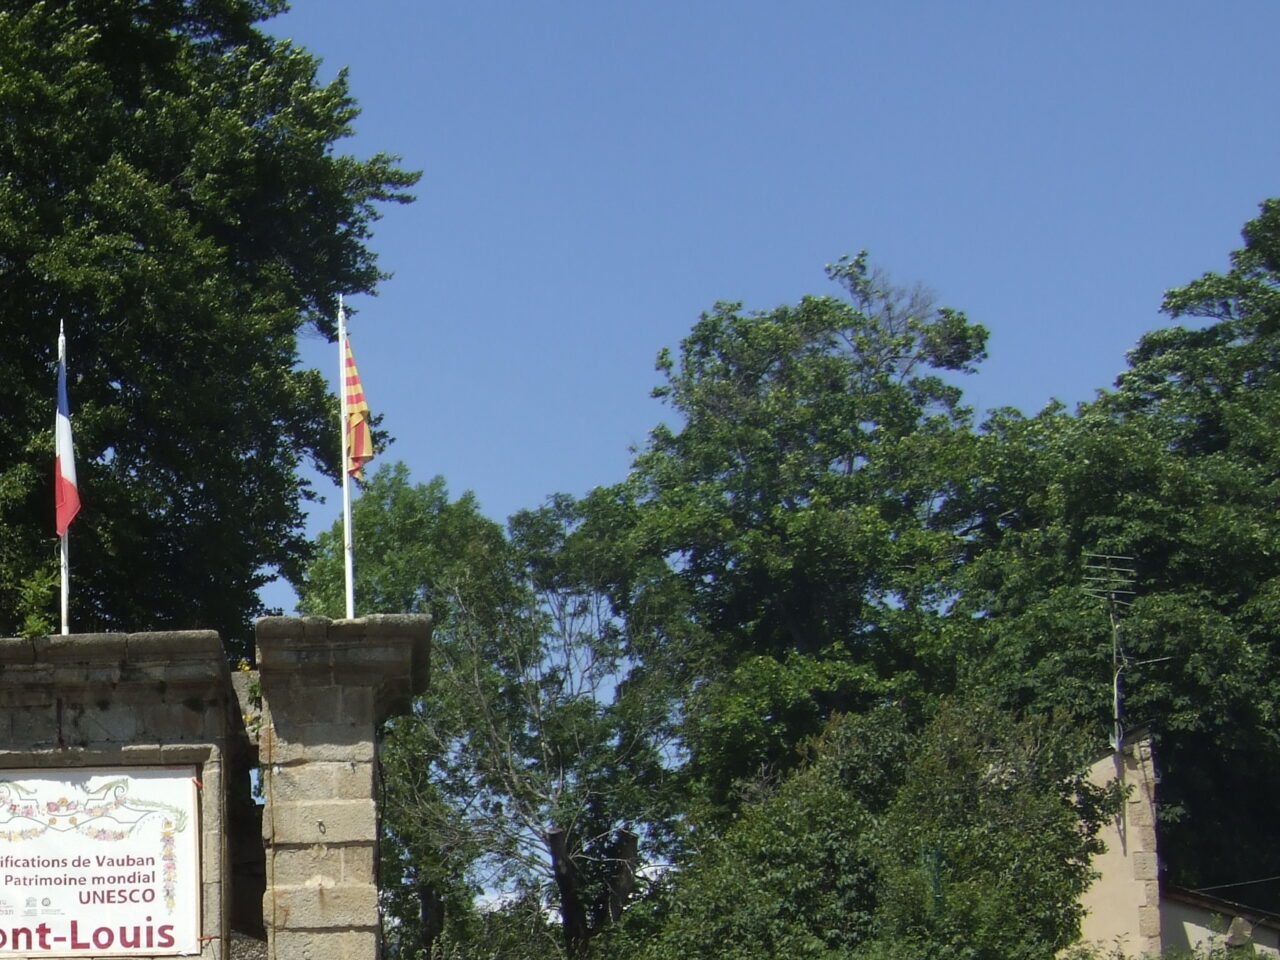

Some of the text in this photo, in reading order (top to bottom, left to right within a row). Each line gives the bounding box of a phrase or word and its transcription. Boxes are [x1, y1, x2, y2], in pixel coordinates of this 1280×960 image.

[71, 855, 91, 867] de
[95, 855, 156, 867] Vauban
[4, 871, 156, 886] Patrimoine mondial
[78, 888, 156, 904] UNESCO
